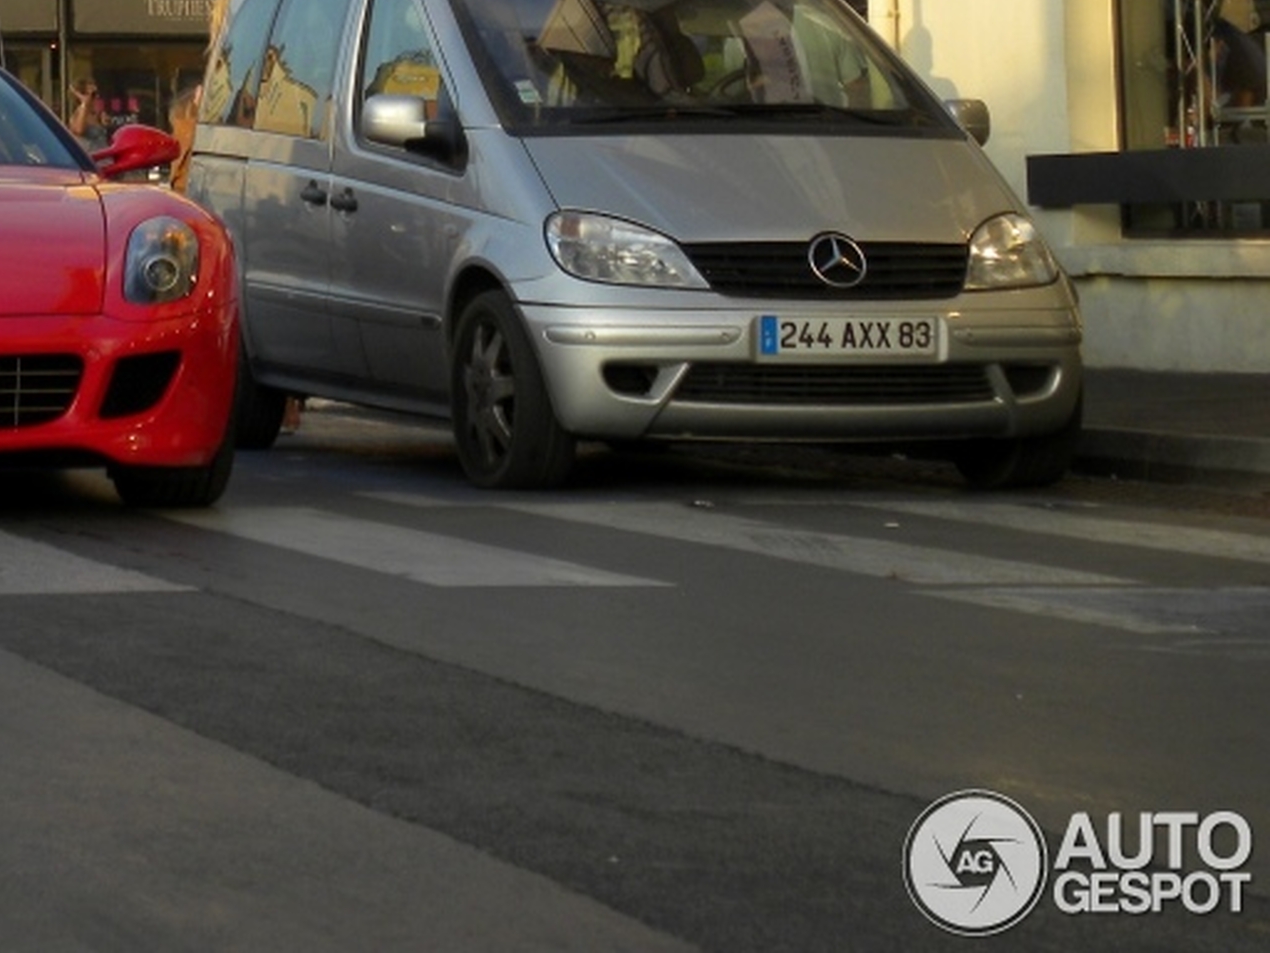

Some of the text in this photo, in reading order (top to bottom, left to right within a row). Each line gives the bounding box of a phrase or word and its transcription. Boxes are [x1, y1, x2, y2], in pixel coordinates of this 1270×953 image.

[780, 321, 833, 349] 244
[841, 322, 891, 349] AXX
[898, 321, 931, 349] 83
